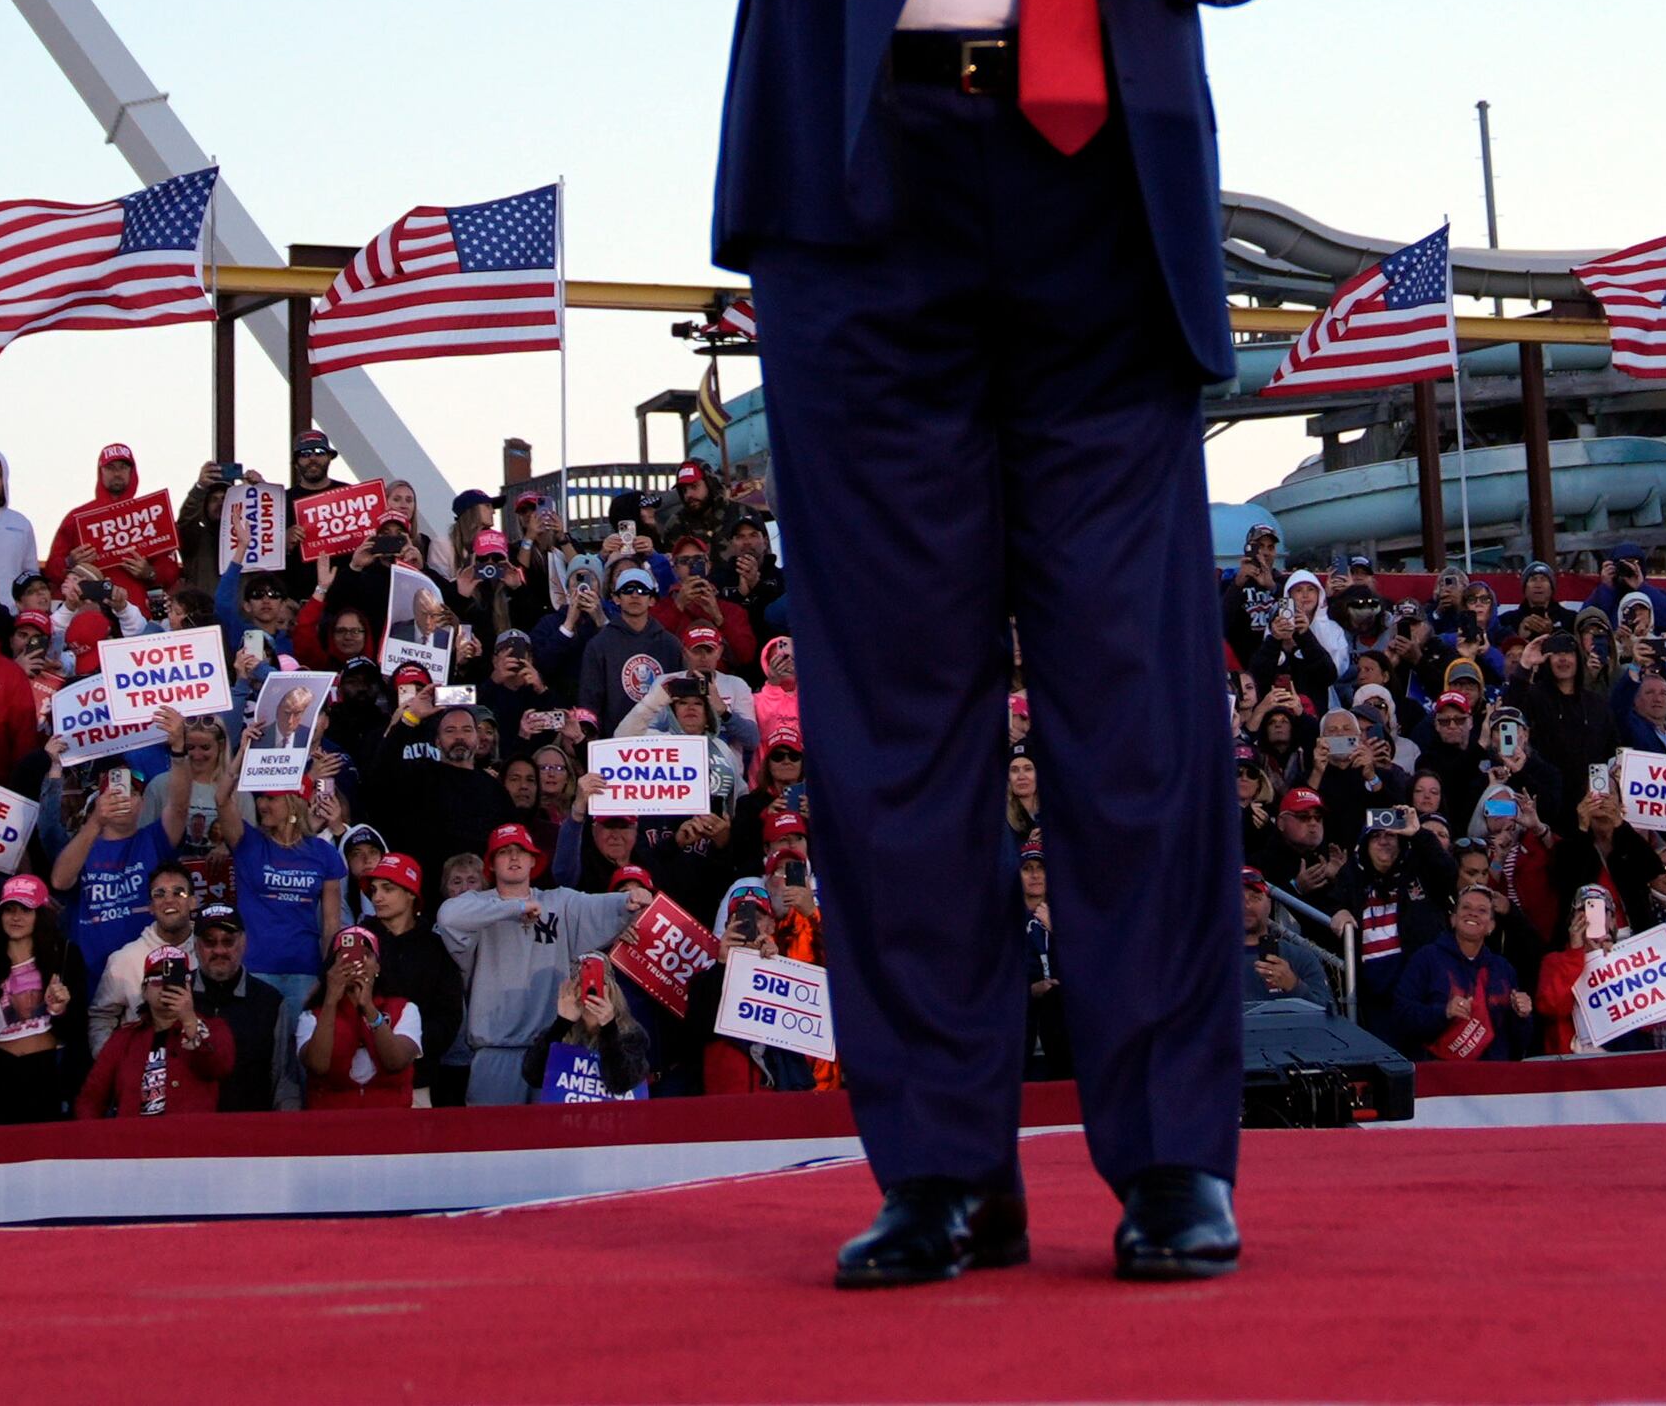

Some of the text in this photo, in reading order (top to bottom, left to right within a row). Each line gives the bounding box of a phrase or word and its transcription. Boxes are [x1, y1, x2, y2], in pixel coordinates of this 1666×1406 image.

[103, 446, 131, 459] TRUMP
[86, 504, 164, 539] TRUMP
[303, 494, 379, 524] TRUMP
[102, 523, 157, 551] 2024
[246, 487, 258, 564] DONALD
[261, 492, 274, 556] TRUMP
[317, 512, 372, 538] 2024
[130, 643, 194, 667] VOTE
[388, 654, 444, 673] SURDER
[401, 647, 432, 660] NEVER
[115, 662, 214, 690] DONALD
[76, 687, 107, 708] VO
[126, 682, 210, 708] TRUMP
[62, 705, 110, 731] DON
[72, 721, 155, 748] TRUM
[260, 755, 291, 764] NEVER
[618, 748, 679, 763] VOTE
[246, 766, 300, 776] SURRENDER
[600, 767, 698, 781] DONALD
[607, 784, 691, 800] TRUMP
[263, 872, 315, 888] TRUMP
[278, 892, 300, 903] 2024
[100, 907, 130, 922] 2024
[650, 913, 717, 971] TRUM
[627, 946, 646, 966] TEXT
[646, 962, 673, 987] TRUMP
[645, 940, 694, 986] 202
[1588, 946, 1661, 989] TRUMP
[752, 974, 820, 1006] TO RIG
[1608, 986, 1666, 1023] VOTE
[738, 1002, 824, 1039] TOO BIG
[573, 1057, 600, 1076] MA
[556, 1073, 635, 1101] AMERA
[565, 1092, 603, 1104] GRE
